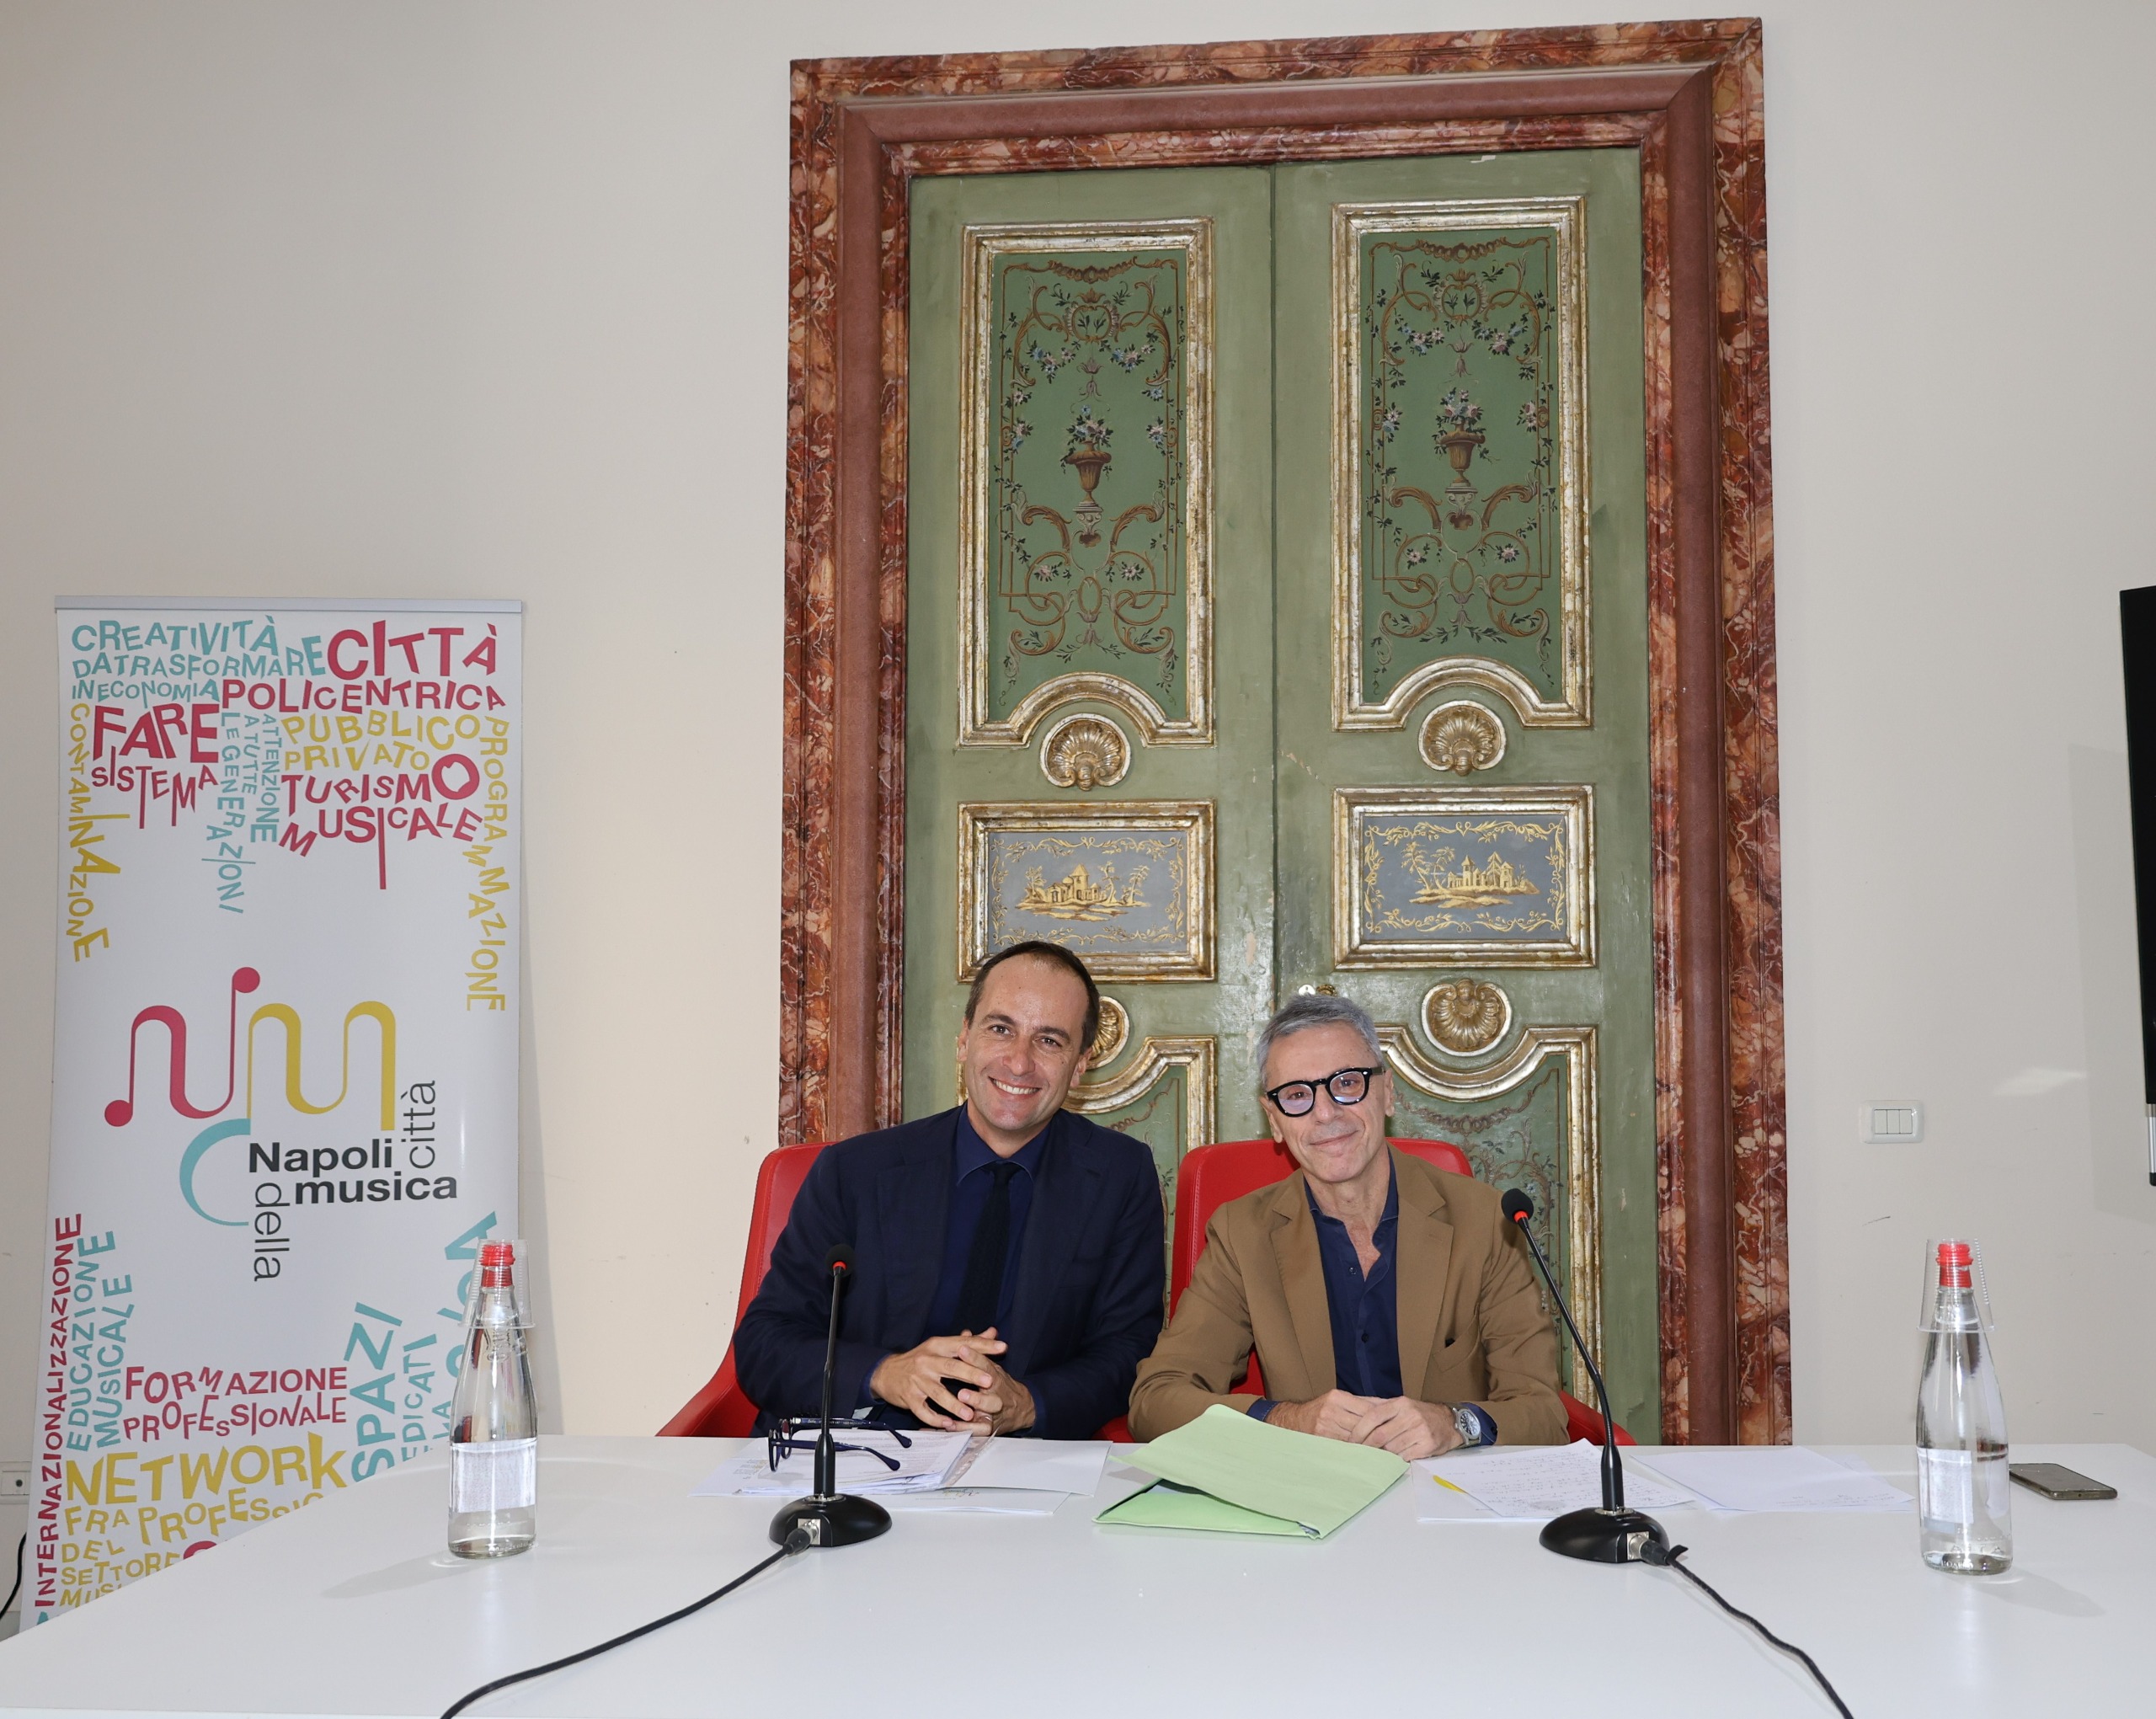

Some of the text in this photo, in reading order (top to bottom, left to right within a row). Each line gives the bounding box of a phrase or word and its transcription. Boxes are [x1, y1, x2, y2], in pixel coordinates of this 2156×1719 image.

[72, 615, 279, 656] CREATIVITÀ
[327, 620, 498, 681] CITTÀ
[221, 677, 506, 715] POLICENTRICA
[93, 703, 220, 763] FARE
[280, 709, 481, 750] PUBBLICO
[284, 739, 430, 771] PRIVATO
[91, 745, 219, 830] SISTEMA
[250, 713, 282, 843] ATTENZIONE
[281, 753, 480, 818] TURISMO
[66, 702, 131, 963] CONTAMINAZIONE
[278, 802, 483, 890] MUSICALE
[462, 716, 510, 1012] PROGRAMMAZIONE
[400, 1080, 436, 1169] città
[248, 1138, 393, 1178] Napoli
[295, 1171, 457, 1204] musica
[253, 1182, 291, 1282] della
[66, 1231, 116, 1452] EDUCAZIONE
[92, 1274, 135, 1449] MUSICALE
[35, 1213, 82, 1607] INTERNAZIONALIZZAZIONE
[125, 1366, 347, 1404] FORMAZIONE
[344, 1301, 403, 1482] SPAZI
[123, 1391, 347, 1443] PROFESSIONALE
[61, 1540, 125, 1563] DEL
[64, 1506, 131, 1536] FRA
